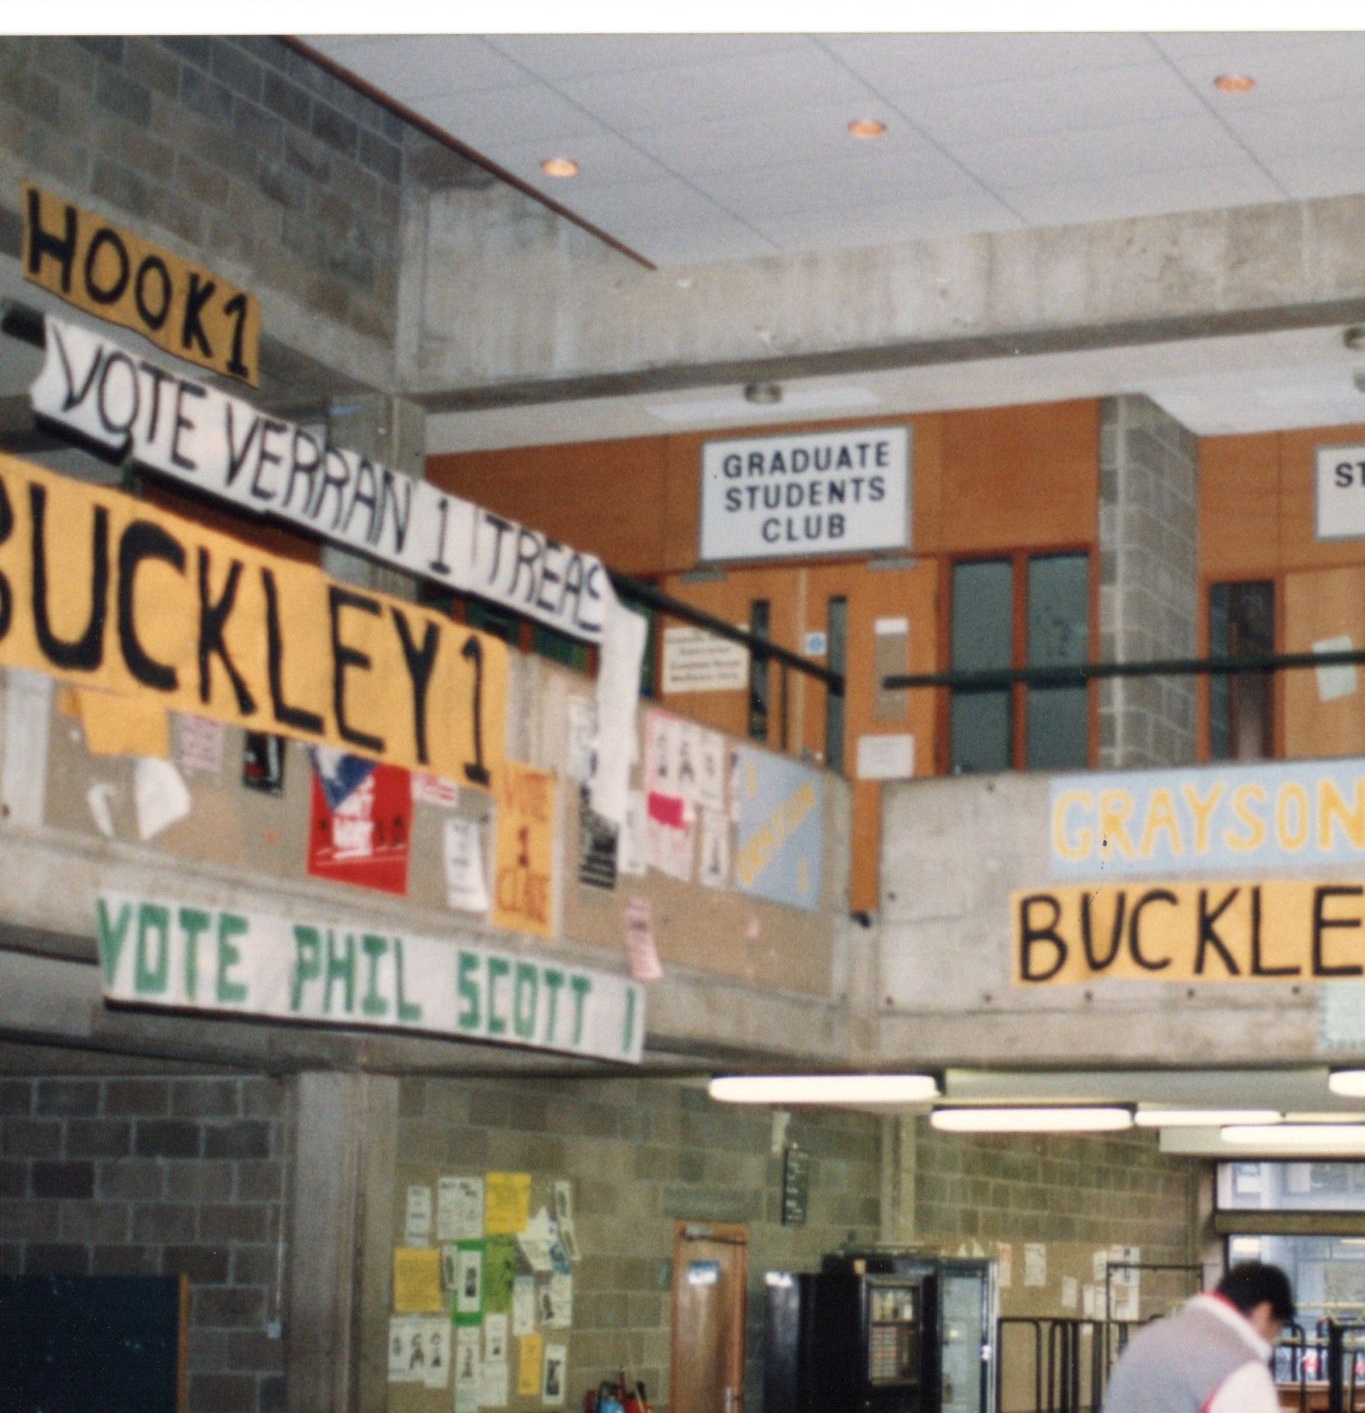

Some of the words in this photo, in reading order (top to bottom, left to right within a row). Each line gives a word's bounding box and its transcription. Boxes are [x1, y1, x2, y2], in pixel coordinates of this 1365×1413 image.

[51, 324, 207, 471] VOTE
[225, 398, 411, 554] VERRAN
[723, 441, 890, 479] GRADUATE
[725, 476, 886, 512] STUDENTS
[762, 514, 846, 543] CLUB
[97, 899, 249, 1003] VOTE
[291, 925, 422, 1023] PHIL
[456, 950, 593, 1046] SCOTT
